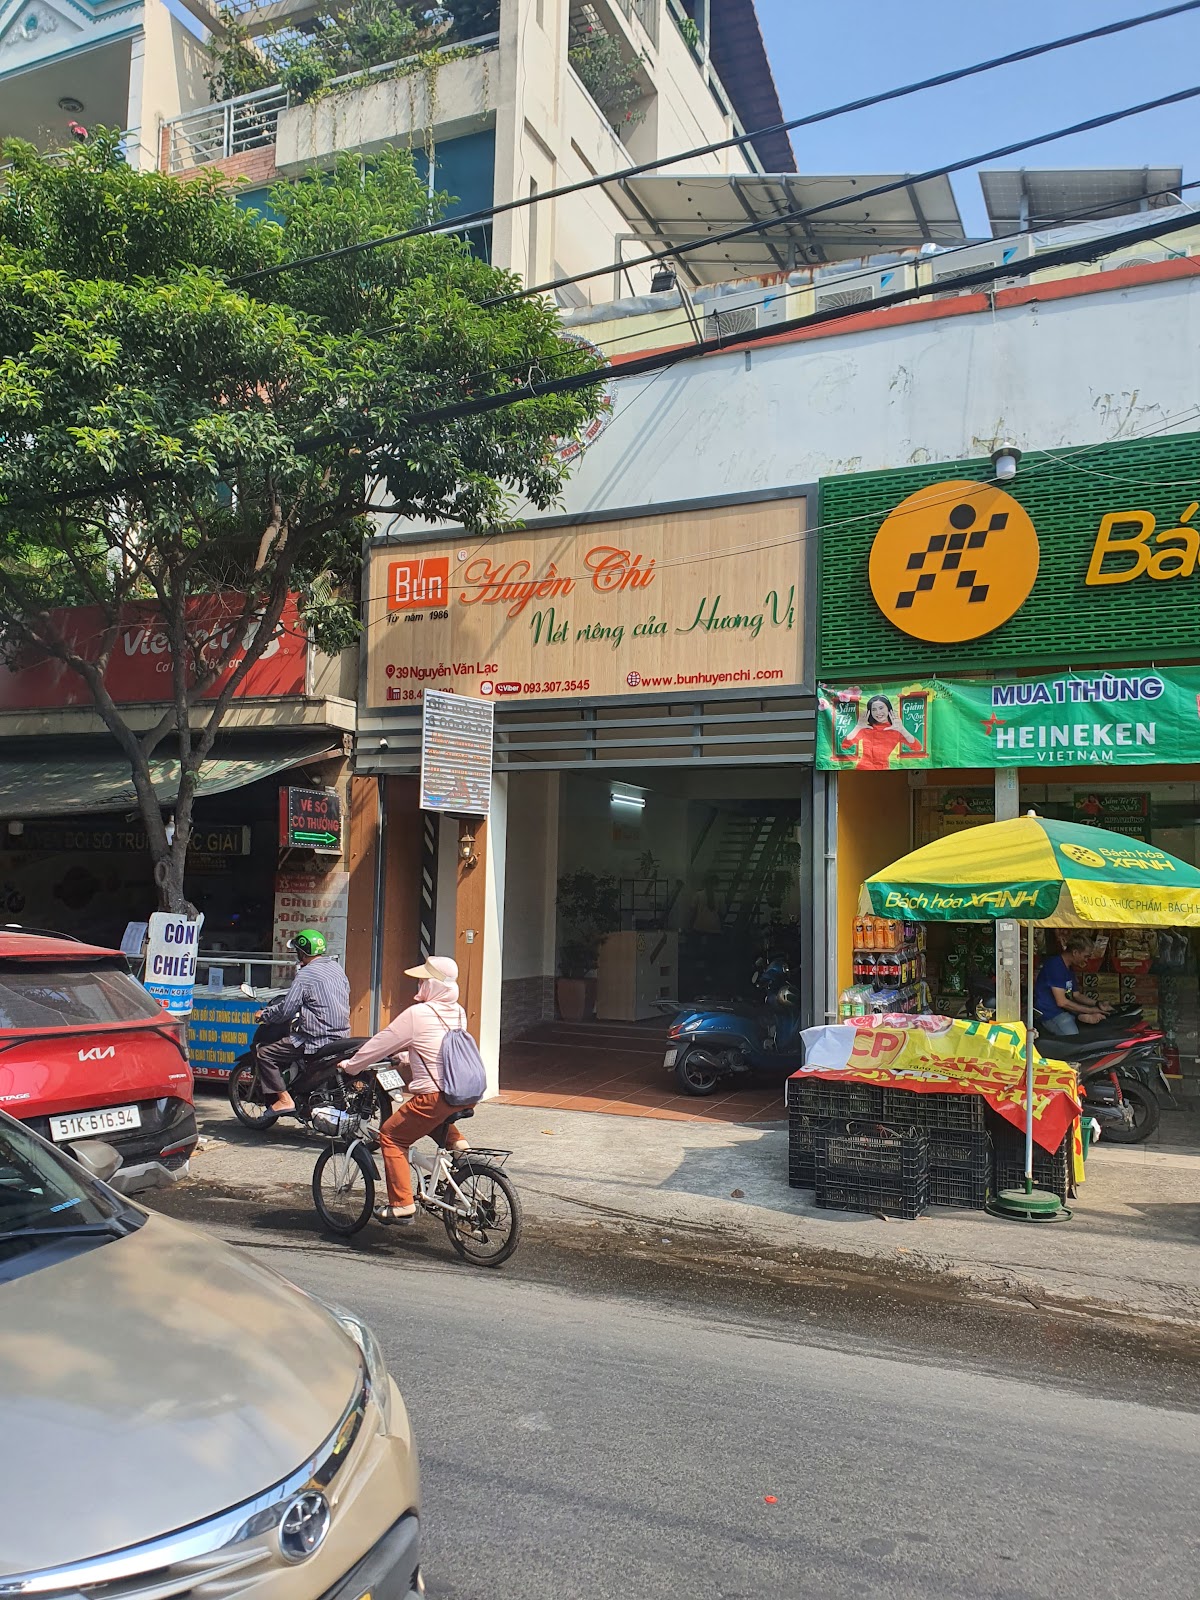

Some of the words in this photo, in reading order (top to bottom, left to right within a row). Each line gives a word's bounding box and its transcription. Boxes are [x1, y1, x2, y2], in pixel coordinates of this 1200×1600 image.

[1085, 502, 1200, 585] Bá
[395, 559, 442, 602] Bún
[460, 558, 575, 618] Huyền
[585, 546, 656, 591] Chi
[405, 613, 424, 622] năm
[429, 610, 449, 620] 1986
[531, 607, 568, 644] Nét
[577, 622, 625, 648] riêng
[633, 616, 668, 636] của
[676, 595, 764, 636] Hương
[765, 585, 795, 627] Vị
[396, 666, 409, 679] 39
[410, 663, 451, 680] Nguyễn
[452, 662, 475, 675] Văn
[477, 662, 499, 677] Lạc
[523, 679, 590, 694] 093.307.3545
[992, 681, 1052, 706] MUA
[1067, 673, 1164, 702] THÙNG
[996, 722, 1156, 748] HEINEKEN
[1037, 750, 1114, 762] VIETNAM
[301, 796, 313, 812] VÉ
[314, 797, 328, 813] SỐ
[1098, 847, 1136, 858] Bách
[1137, 849, 1164, 859] hóa
[1112, 858, 1176, 871] XANH
[886, 890, 931, 909] Bách
[932, 892, 963, 909] hóa
[963, 890, 1039, 908] XANH
[164, 920, 195, 945] CÒN
[852, 1029, 899, 1058] CP
[78, 1046, 115, 1062] KIA
[0, 1093, 30, 1102] TAGE
[59, 1110, 134, 1136] 51K-616.94
